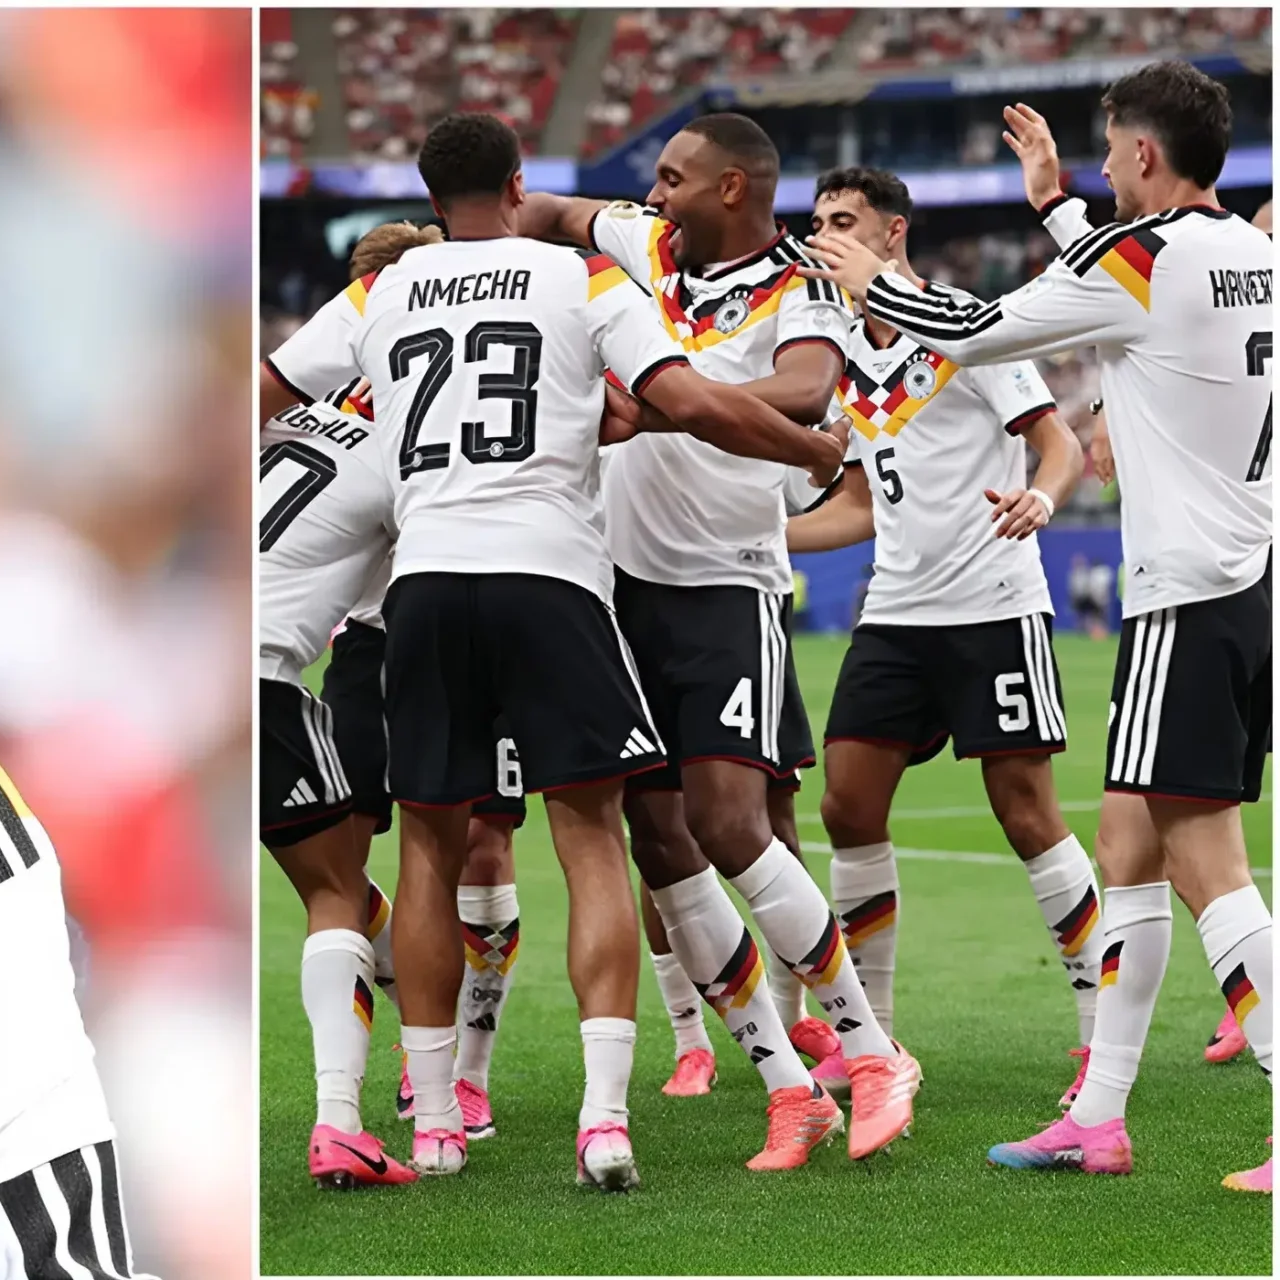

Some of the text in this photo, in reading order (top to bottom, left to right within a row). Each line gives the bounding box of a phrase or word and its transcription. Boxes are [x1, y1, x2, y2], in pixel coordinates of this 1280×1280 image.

[408, 269, 531, 312] NMECHA
[388, 320, 543, 482] 23
[875, 447, 905, 505] 5
[720, 677, 755, 738] 4
[995, 672, 1030, 732] 5
[496, 737, 523, 798] 6
